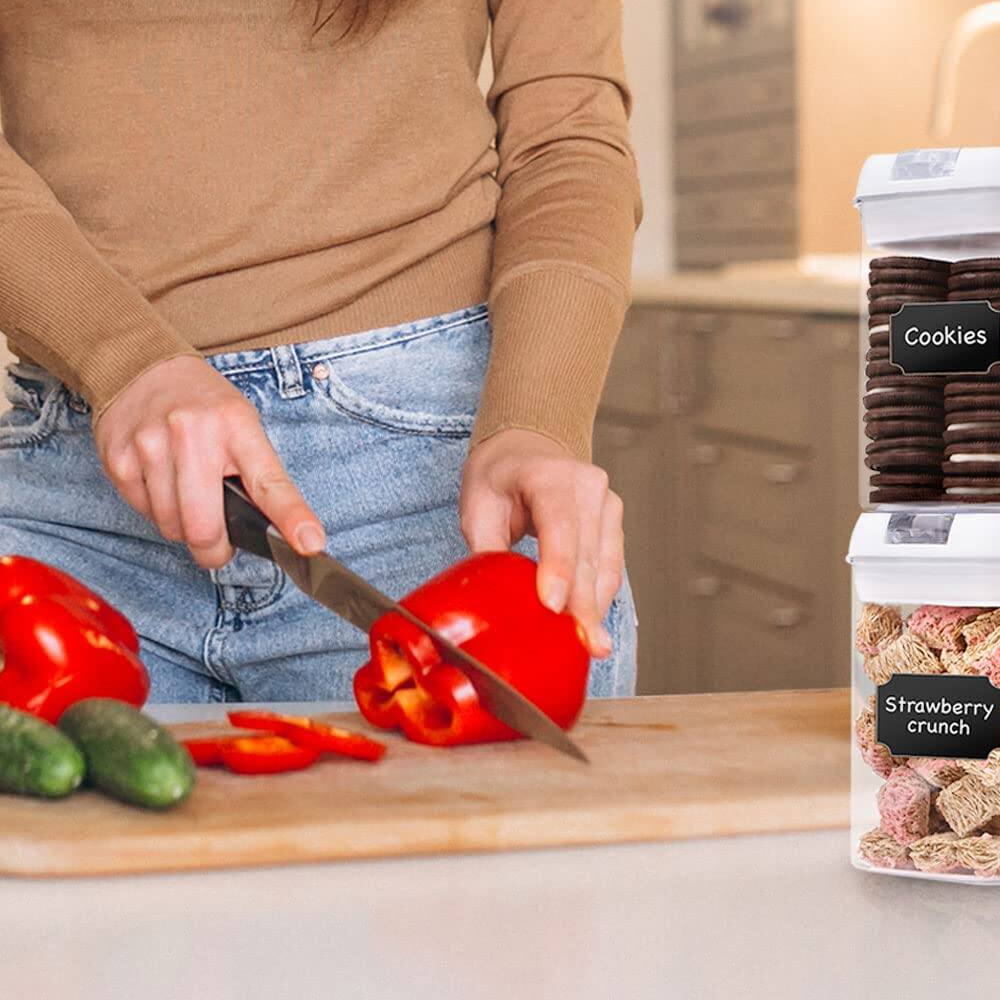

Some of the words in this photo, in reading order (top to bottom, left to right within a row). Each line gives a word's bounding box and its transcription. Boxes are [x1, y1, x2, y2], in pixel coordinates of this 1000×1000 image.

[905, 326, 986, 345] Cookies
[886, 697, 994, 719] Strawberry
[908, 719, 969, 735] crunch
